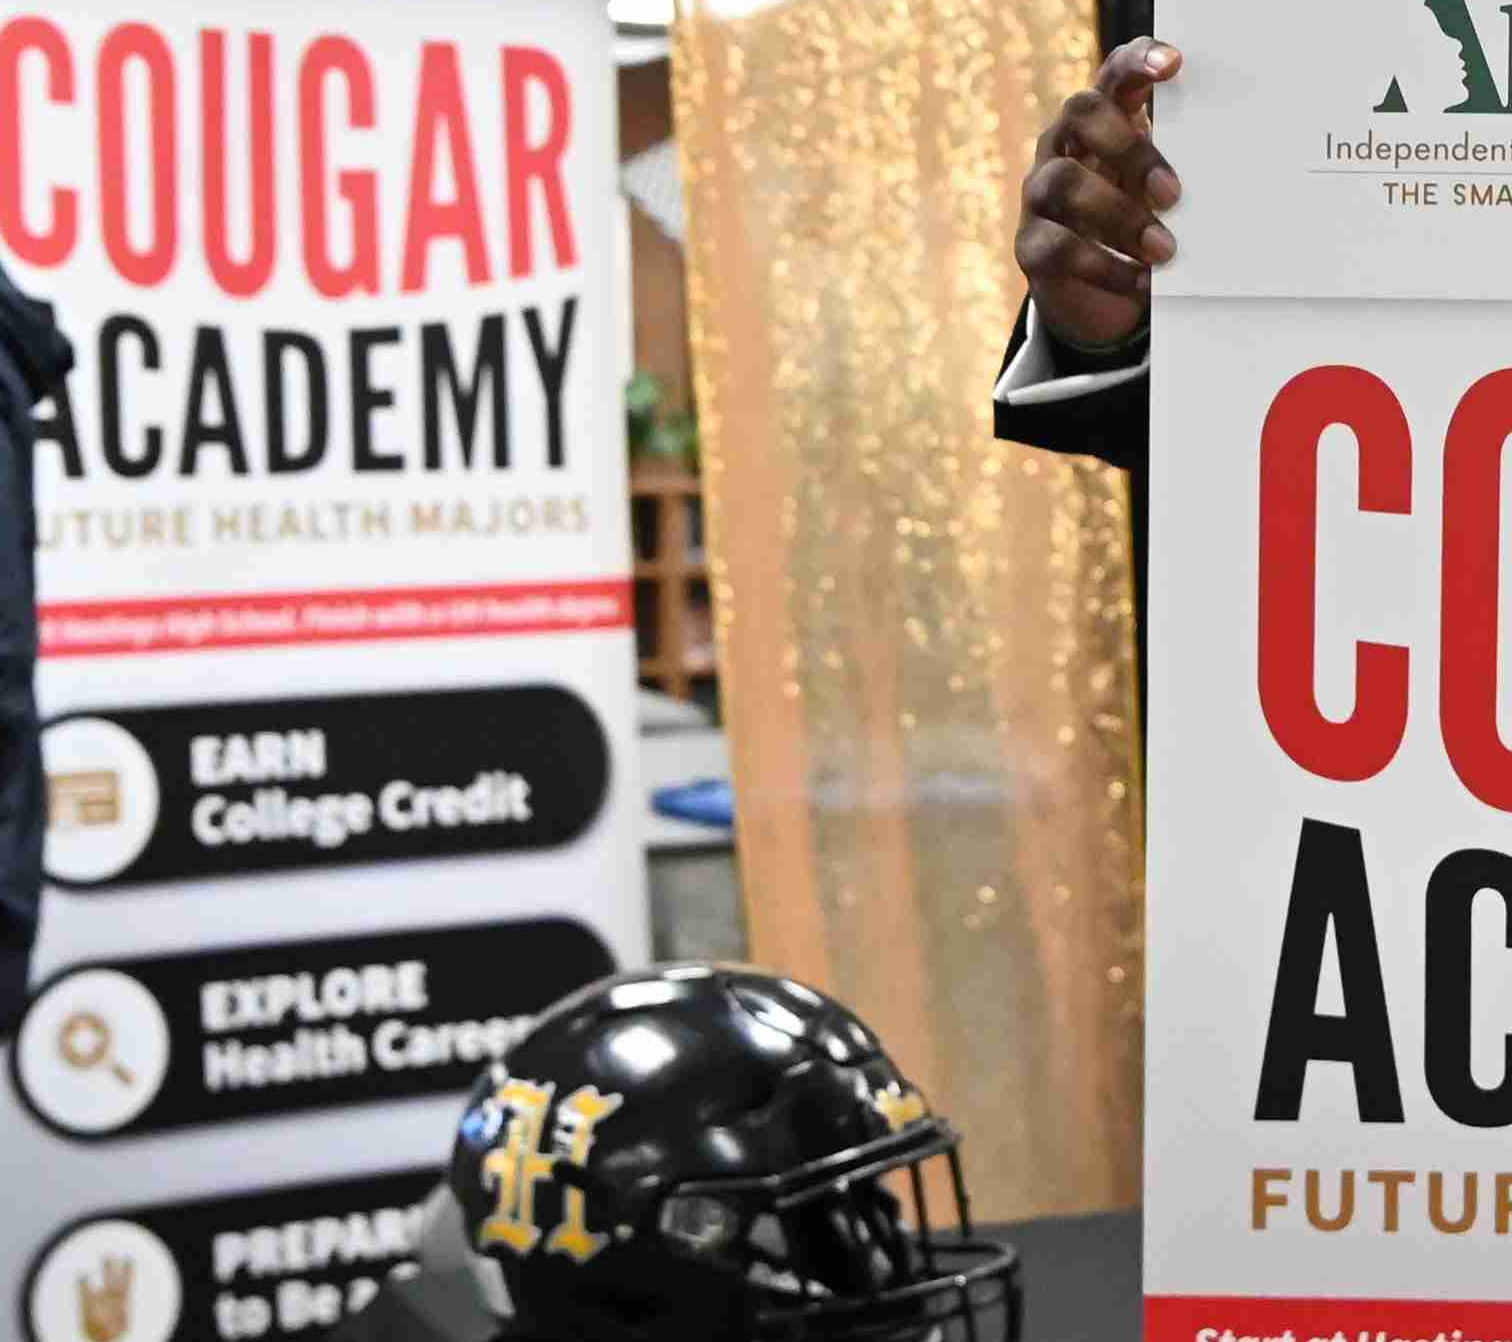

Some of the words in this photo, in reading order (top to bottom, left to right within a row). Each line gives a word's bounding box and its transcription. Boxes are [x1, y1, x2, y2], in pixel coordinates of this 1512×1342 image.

[1382, 182, 1438, 206] THE
[33, 295, 578, 479] ACADEMY
[213, 501, 393, 545] HEALTH
[408, 494, 591, 538] MAJORS
[190, 729, 327, 786] EARN
[191, 788, 374, 847] College
[378, 770, 534, 830] Credit
[201, 960, 429, 1033] EXPLORE
[202, 1023, 367, 1093] Health
[214, 1291, 272, 1342] to
[277, 1278, 343, 1333] Be
